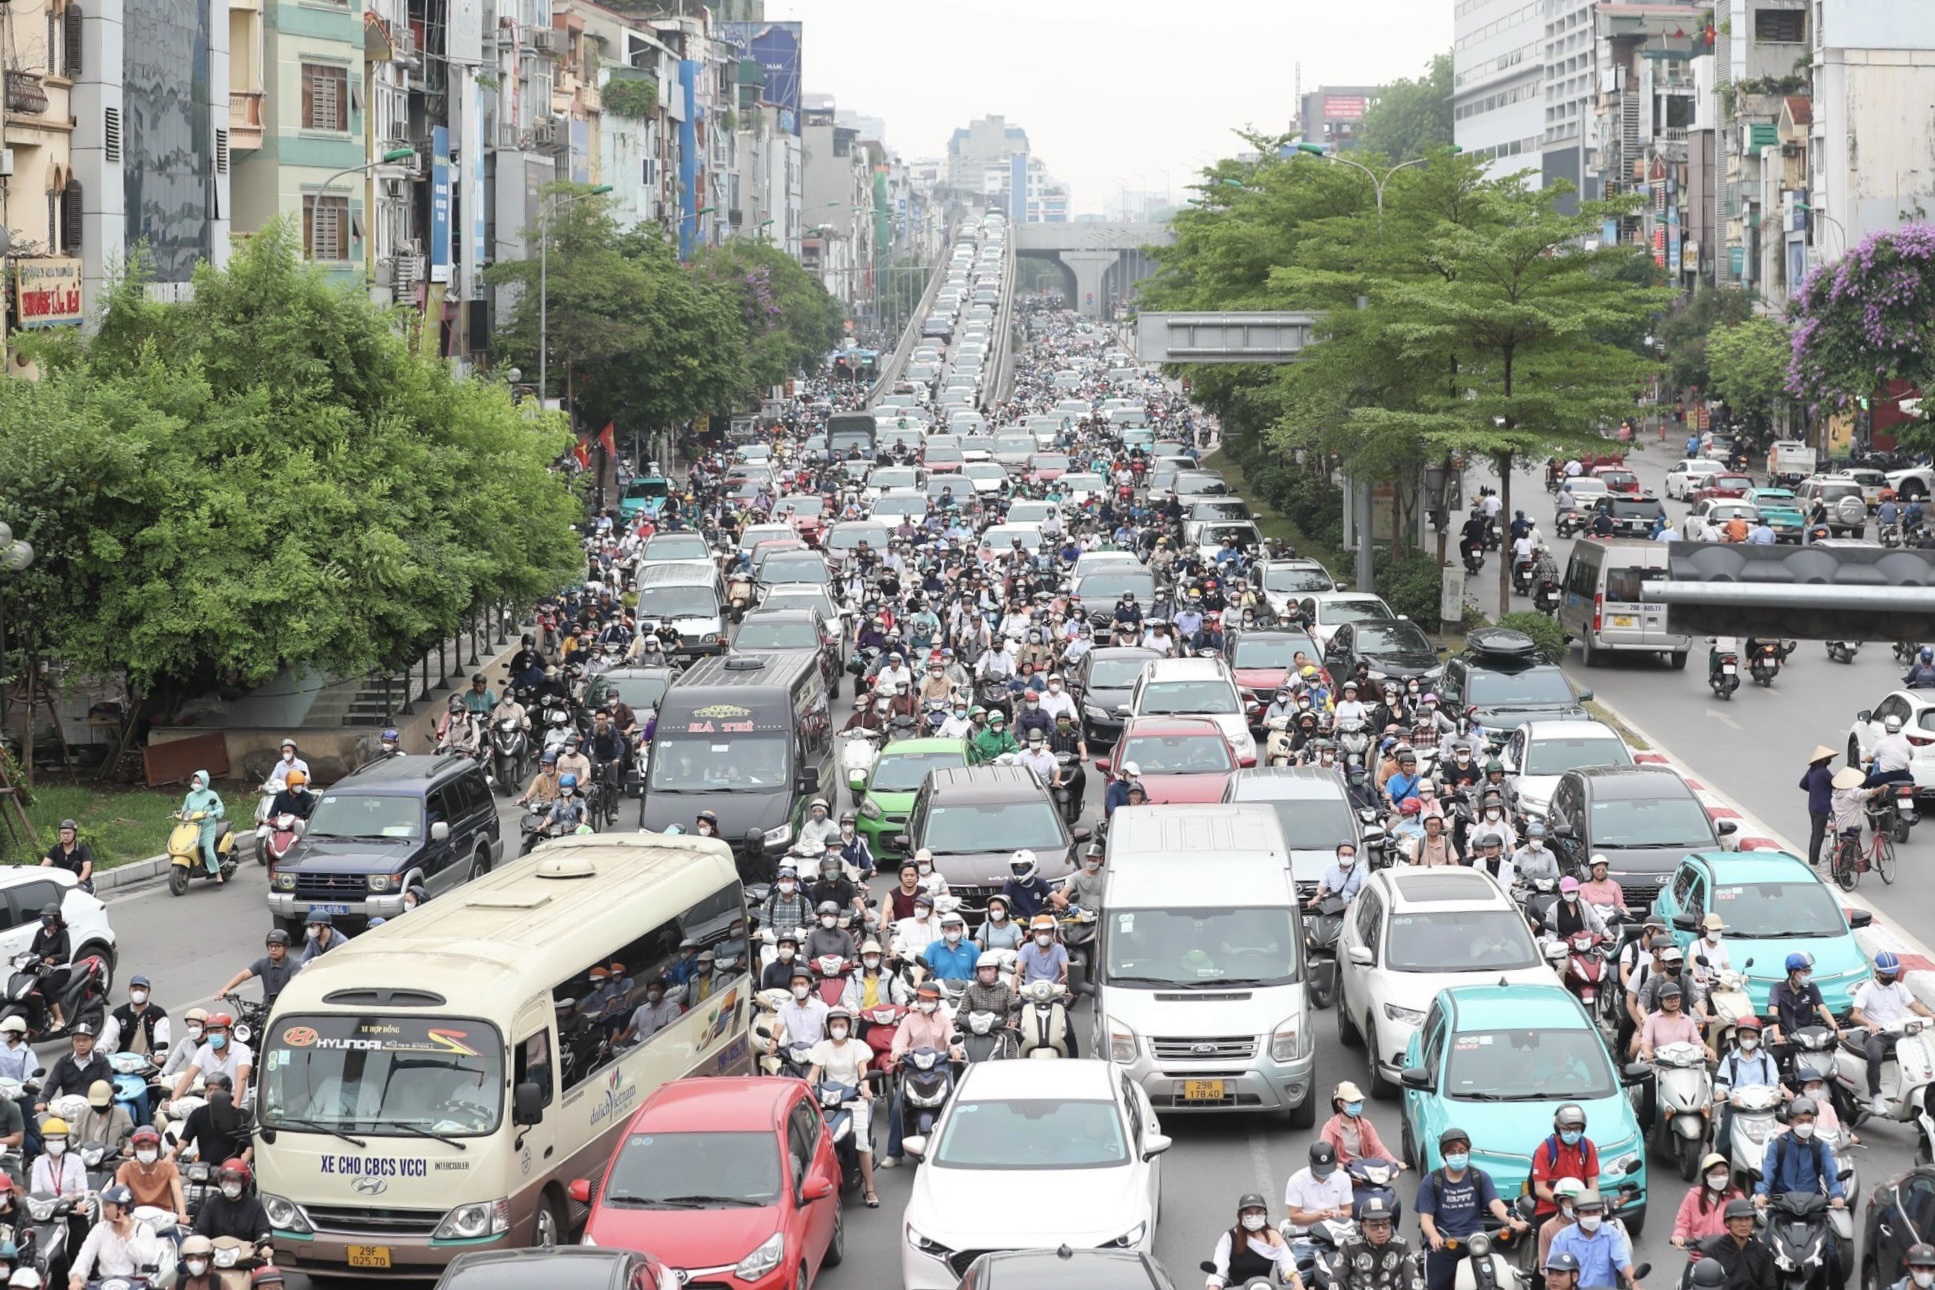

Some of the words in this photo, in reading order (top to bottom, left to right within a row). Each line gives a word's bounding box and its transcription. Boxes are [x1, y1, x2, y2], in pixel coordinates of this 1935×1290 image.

[316, 1038, 382, 1050] HYUNDAI
[1196, 1045, 1212, 1053] Ford
[1196, 1081, 1213, 1090] 29B
[1190, 1090, 1220, 1098] 178.40
[321, 1155, 335, 1173] XE
[338, 1156, 361, 1174] CHO
[364, 1157, 396, 1176] CBCS
[399, 1158, 427, 1176] VCCI
[434, 1161, 470, 1171] INTERCOOLER
[360, 1246, 377, 1256] 29F
[353, 1256, 386, 1266] 025.70
